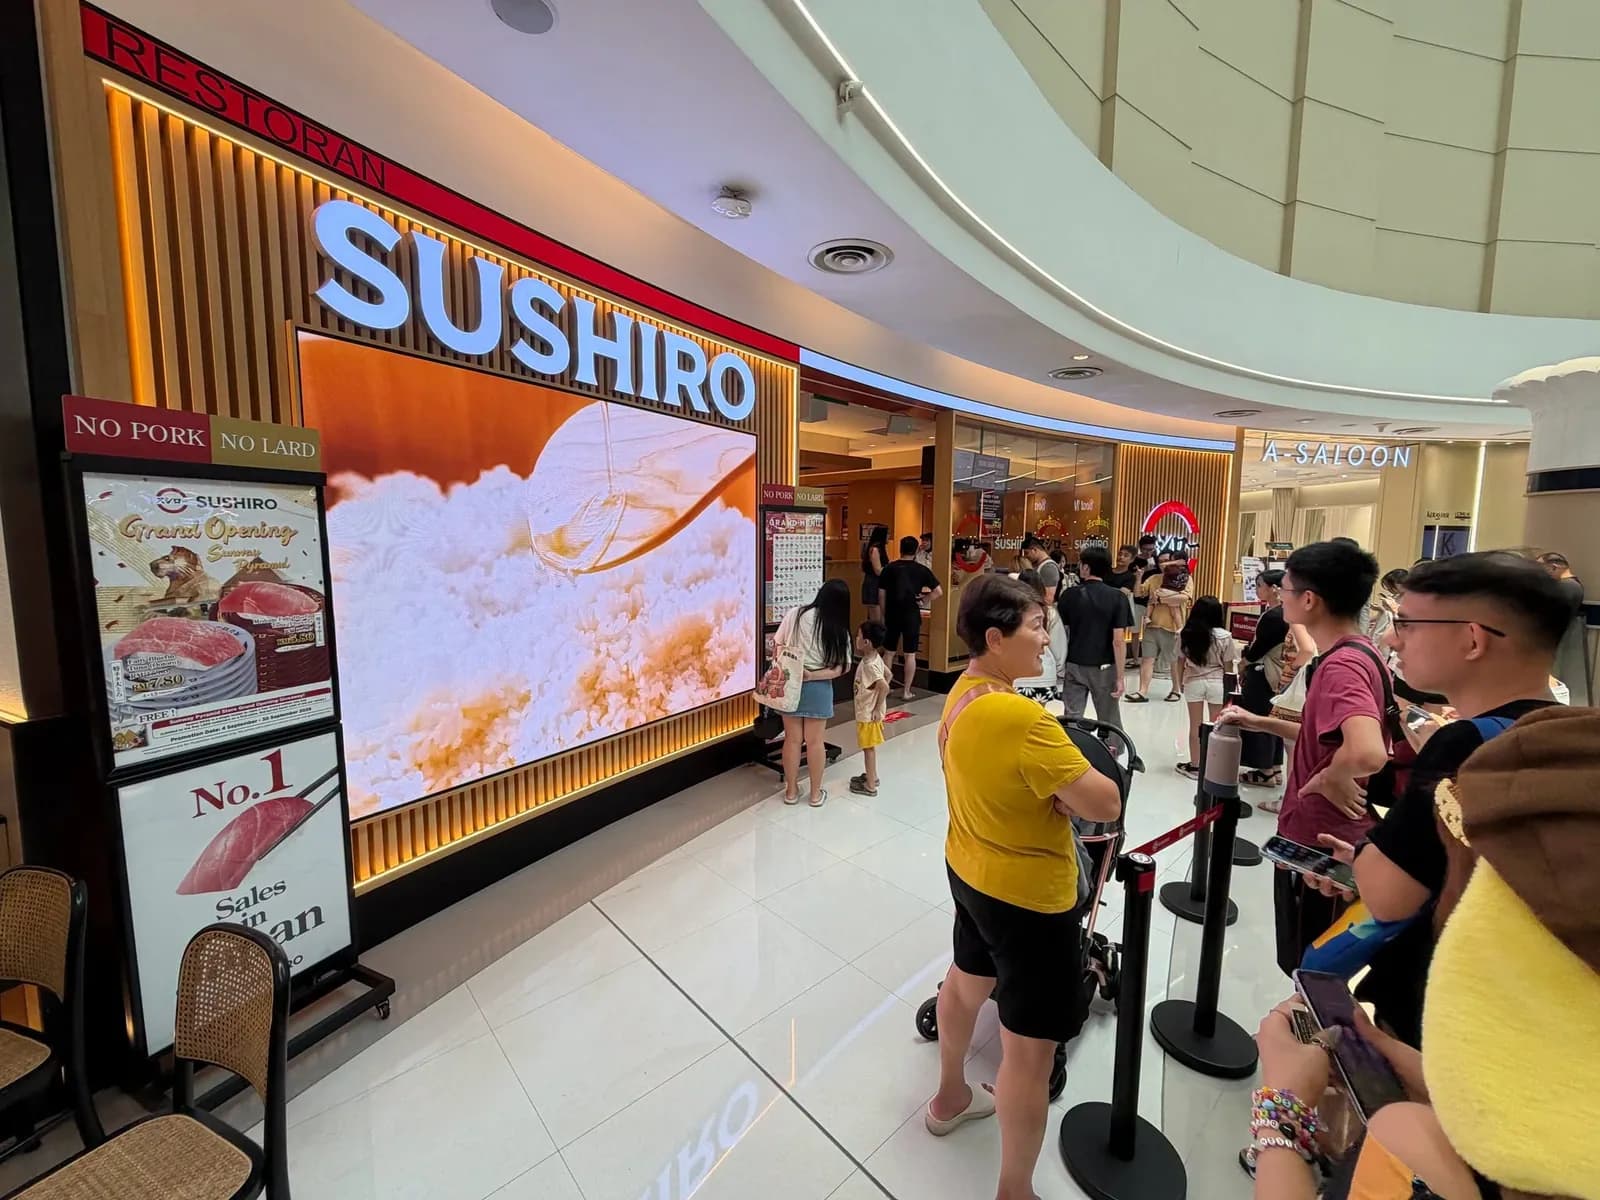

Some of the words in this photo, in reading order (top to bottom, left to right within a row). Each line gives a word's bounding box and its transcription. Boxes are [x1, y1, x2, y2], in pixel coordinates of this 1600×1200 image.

[103, 19, 386, 189] RESTORAN
[312, 200, 756, 421] SUSHIRO
[73, 415, 121, 438] NO
[131, 422, 206, 447] PORK
[220, 433, 254, 451] NO
[262, 437, 316, 458] LARD
[1262, 440, 1410, 468] A-SALOON
[196, 496, 278, 510] SUSHIRO
[763, 490, 774, 498] NO
[775, 491, 793, 500] PORK
[807, 493, 823, 501] LARD
[119, 514, 200, 542] Grand
[204, 516, 298, 546] Opening
[189, 748, 294, 818] No.1
[215, 880, 287, 920] Sales
[241, 909, 267, 928] in
